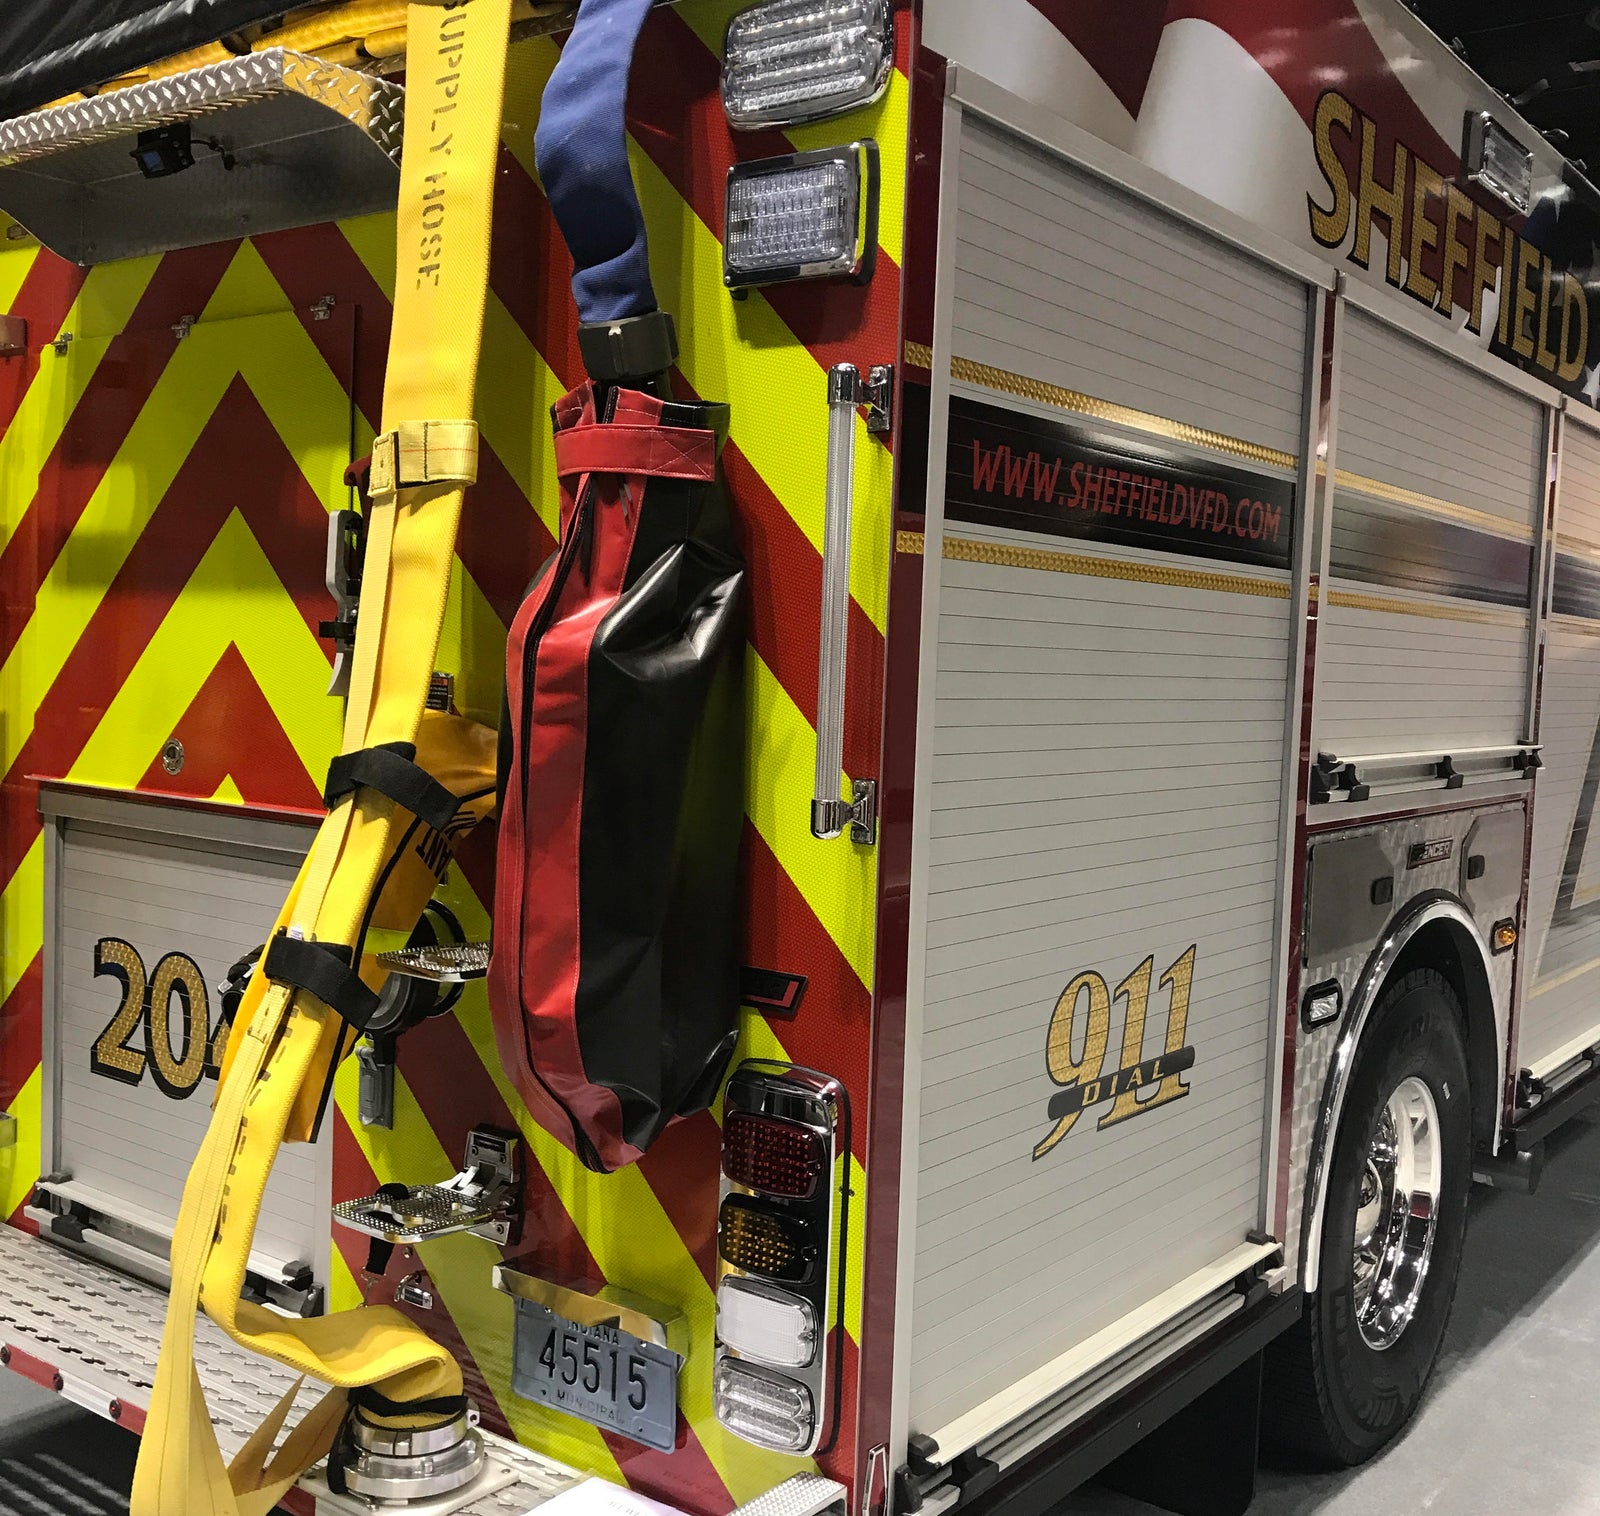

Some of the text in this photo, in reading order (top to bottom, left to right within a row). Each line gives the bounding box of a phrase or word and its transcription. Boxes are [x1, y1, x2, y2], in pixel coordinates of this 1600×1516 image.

[416, 171, 447, 290] HOSE
[1307, 88, 1588, 382] SHEFFIELD
[972, 439, 1281, 543] WWW.SHEFFIELDVFD.COM
[1032, 943, 1197, 1162] 911
[1082, 1059, 1165, 1107] DIAL
[538, 1328, 648, 1411] 45515
